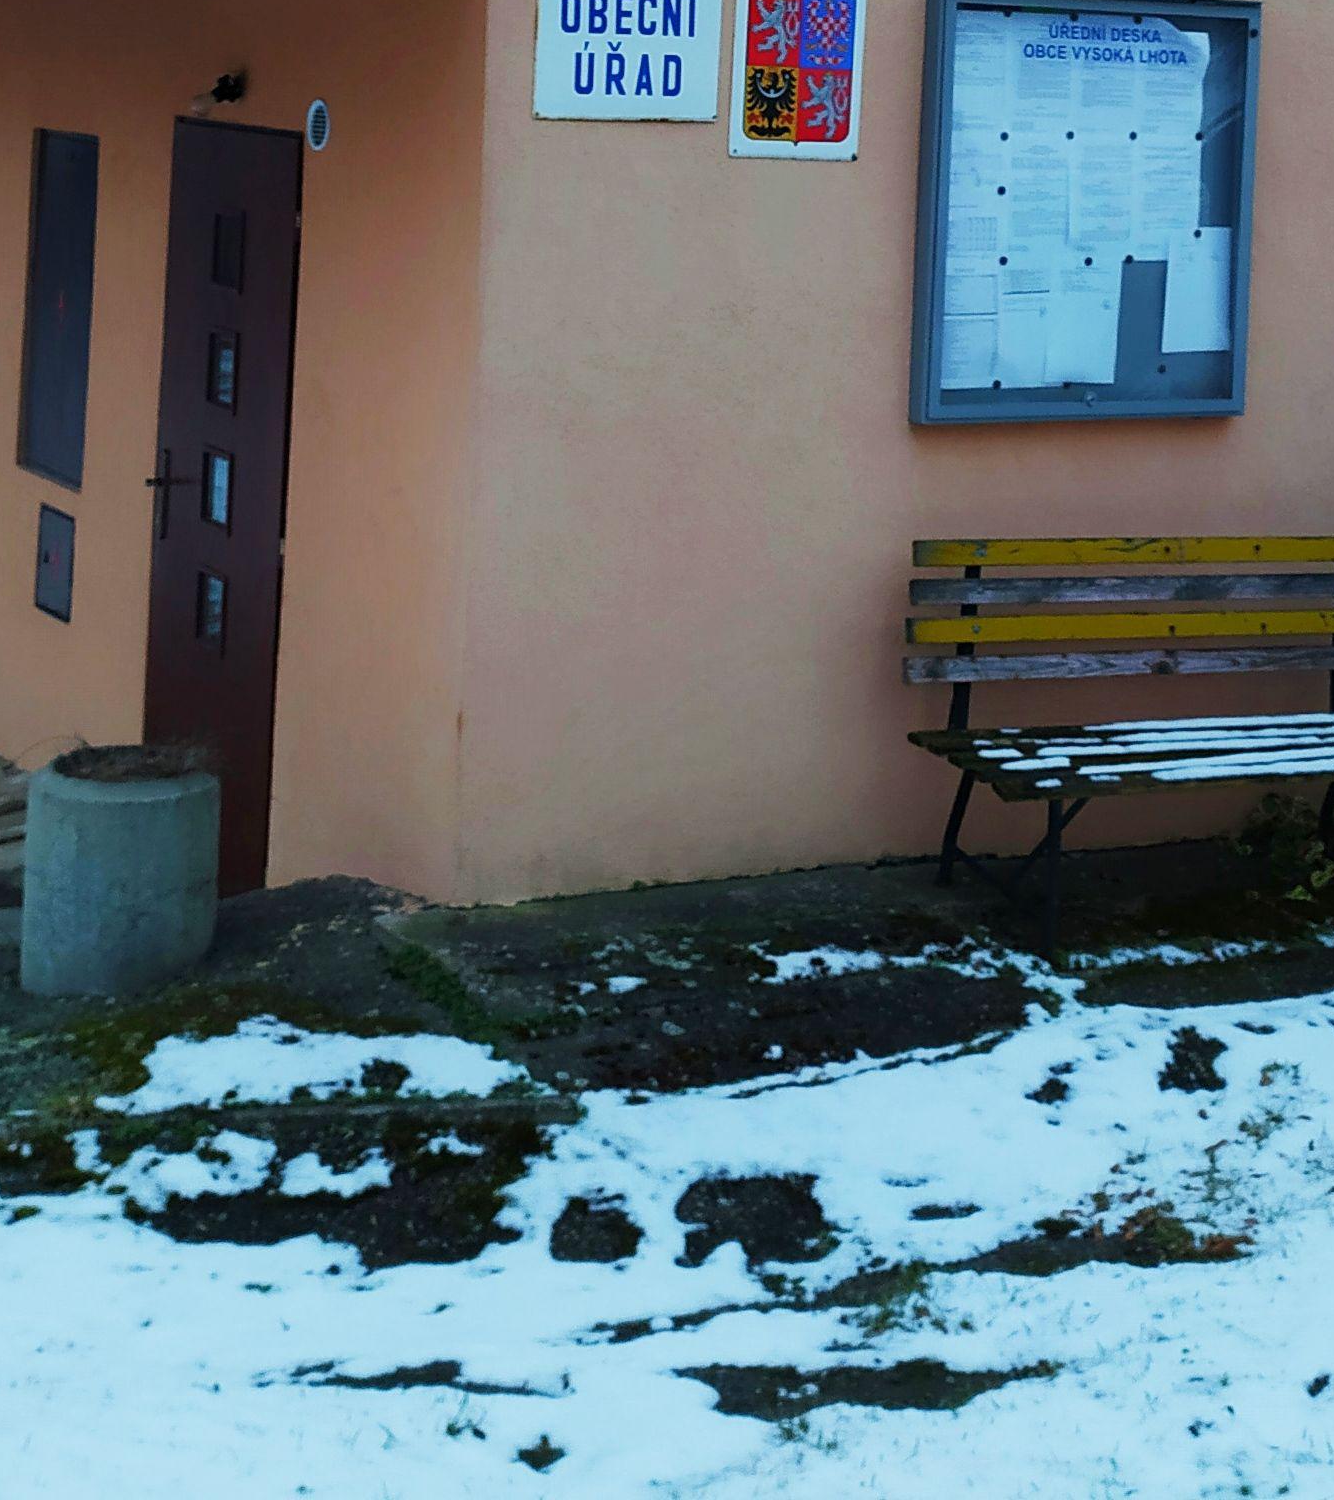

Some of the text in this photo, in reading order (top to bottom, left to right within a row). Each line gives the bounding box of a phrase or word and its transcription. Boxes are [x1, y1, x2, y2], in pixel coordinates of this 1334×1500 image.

[1048, 21, 1163, 43] ÚŘEDNÍ DESKA
[1023, 43, 1188, 65] OBCE VYSOKÁ LHOTA
[573, 41, 683, 97] ÚŘAD
